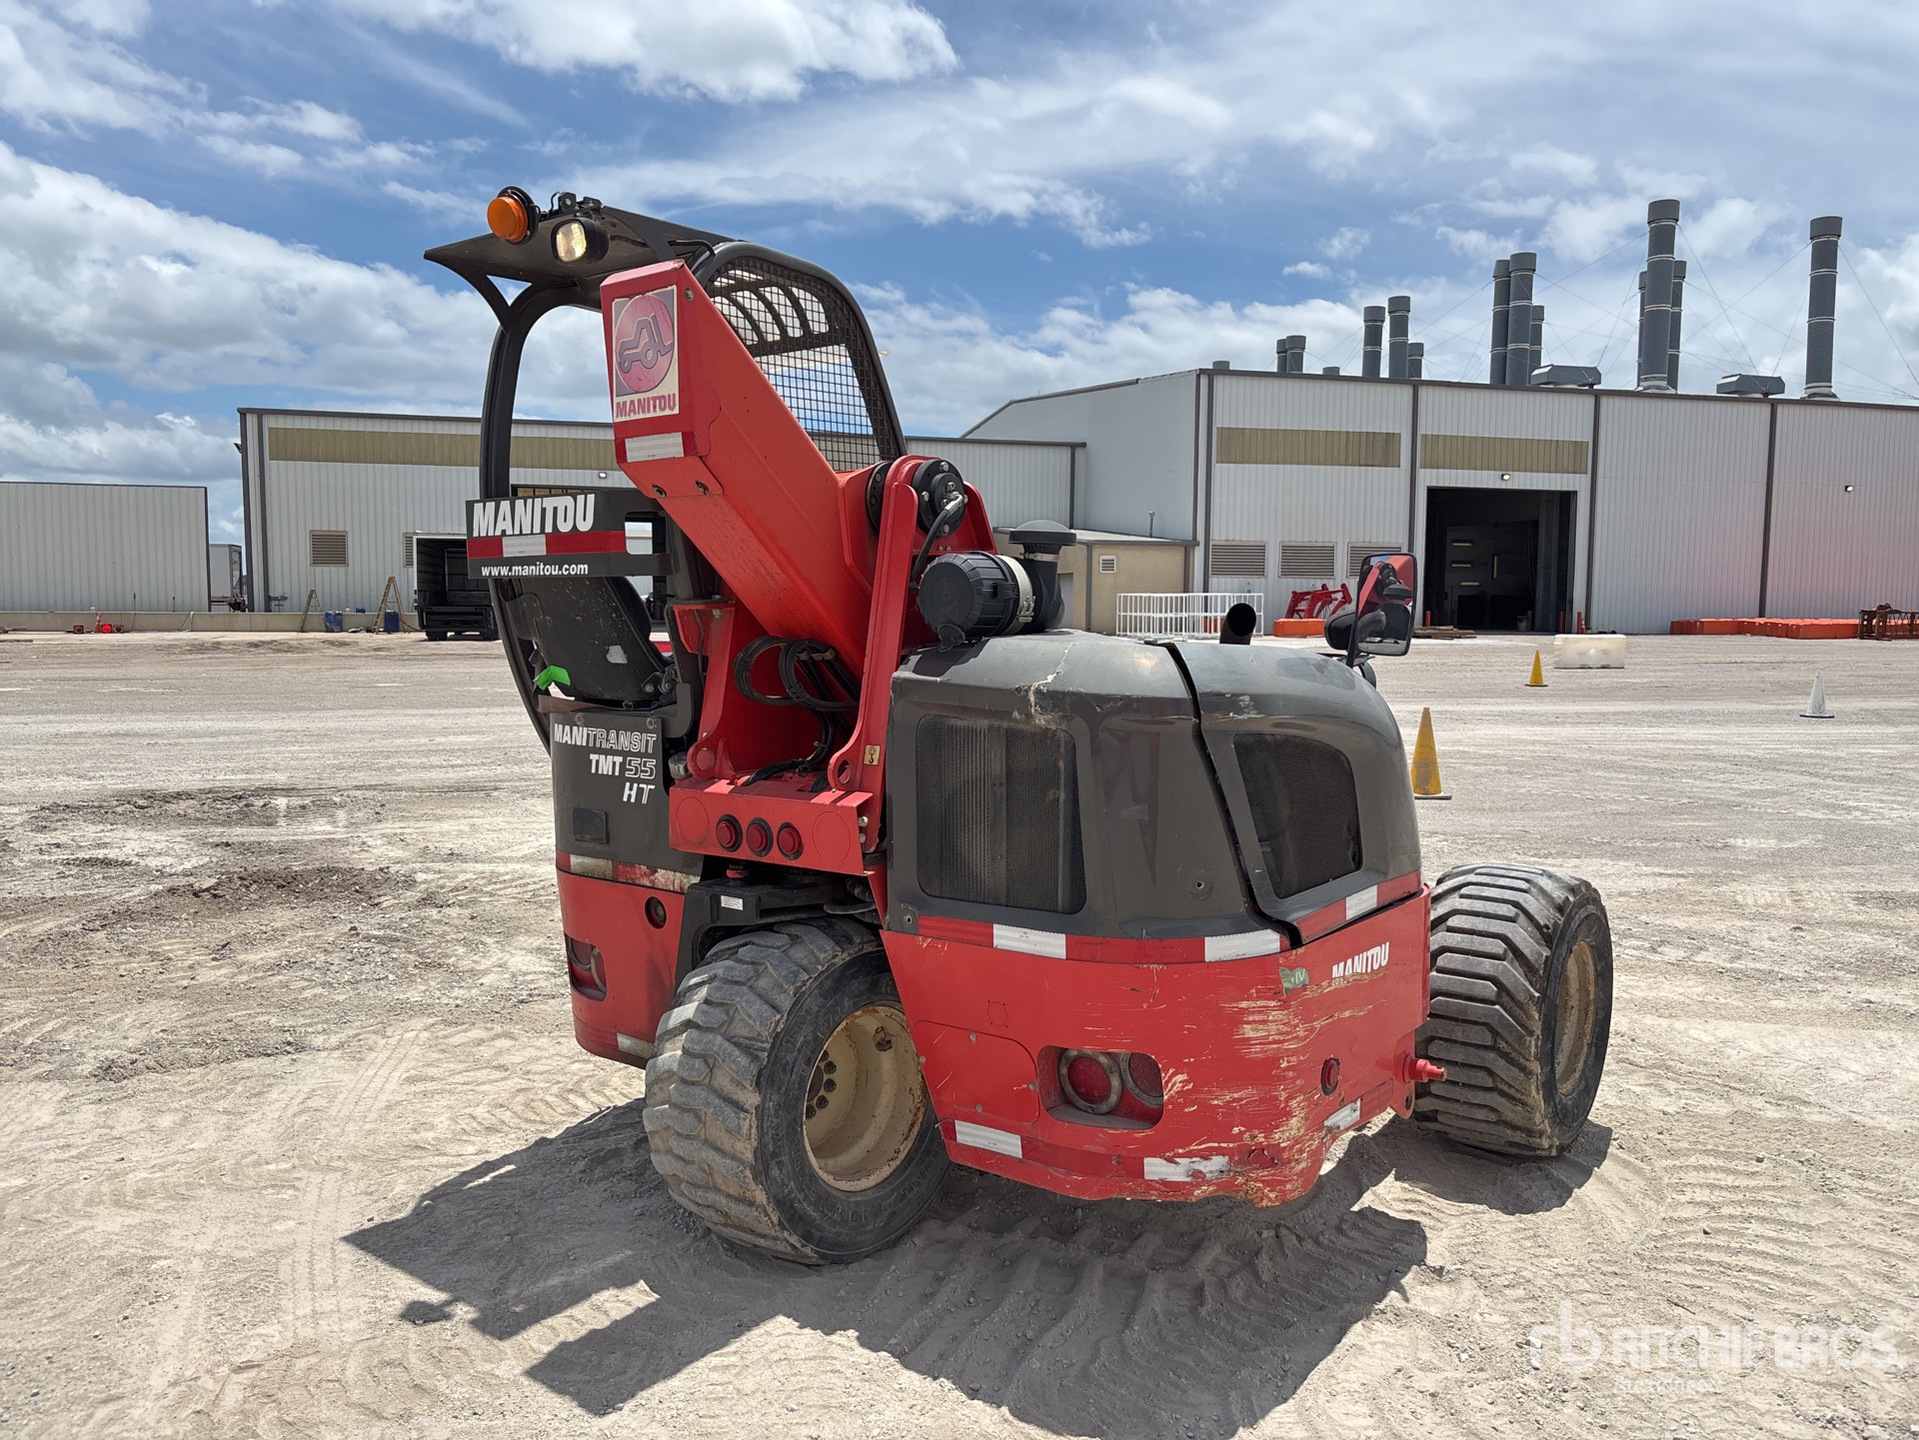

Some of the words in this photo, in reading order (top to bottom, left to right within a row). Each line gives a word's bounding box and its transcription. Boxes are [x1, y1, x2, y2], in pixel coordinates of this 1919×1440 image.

[615, 393, 677, 418] MANITOU
[473, 494, 595, 537] MANITOU
[481, 561, 589, 577] www.manitou.com
[554, 723, 657, 753] MANITRANSIT
[589, 753, 623, 776] TMT
[625, 756, 656, 779] 55
[622, 782, 656, 805] HT
[1332, 942, 1390, 978] MANITOU
